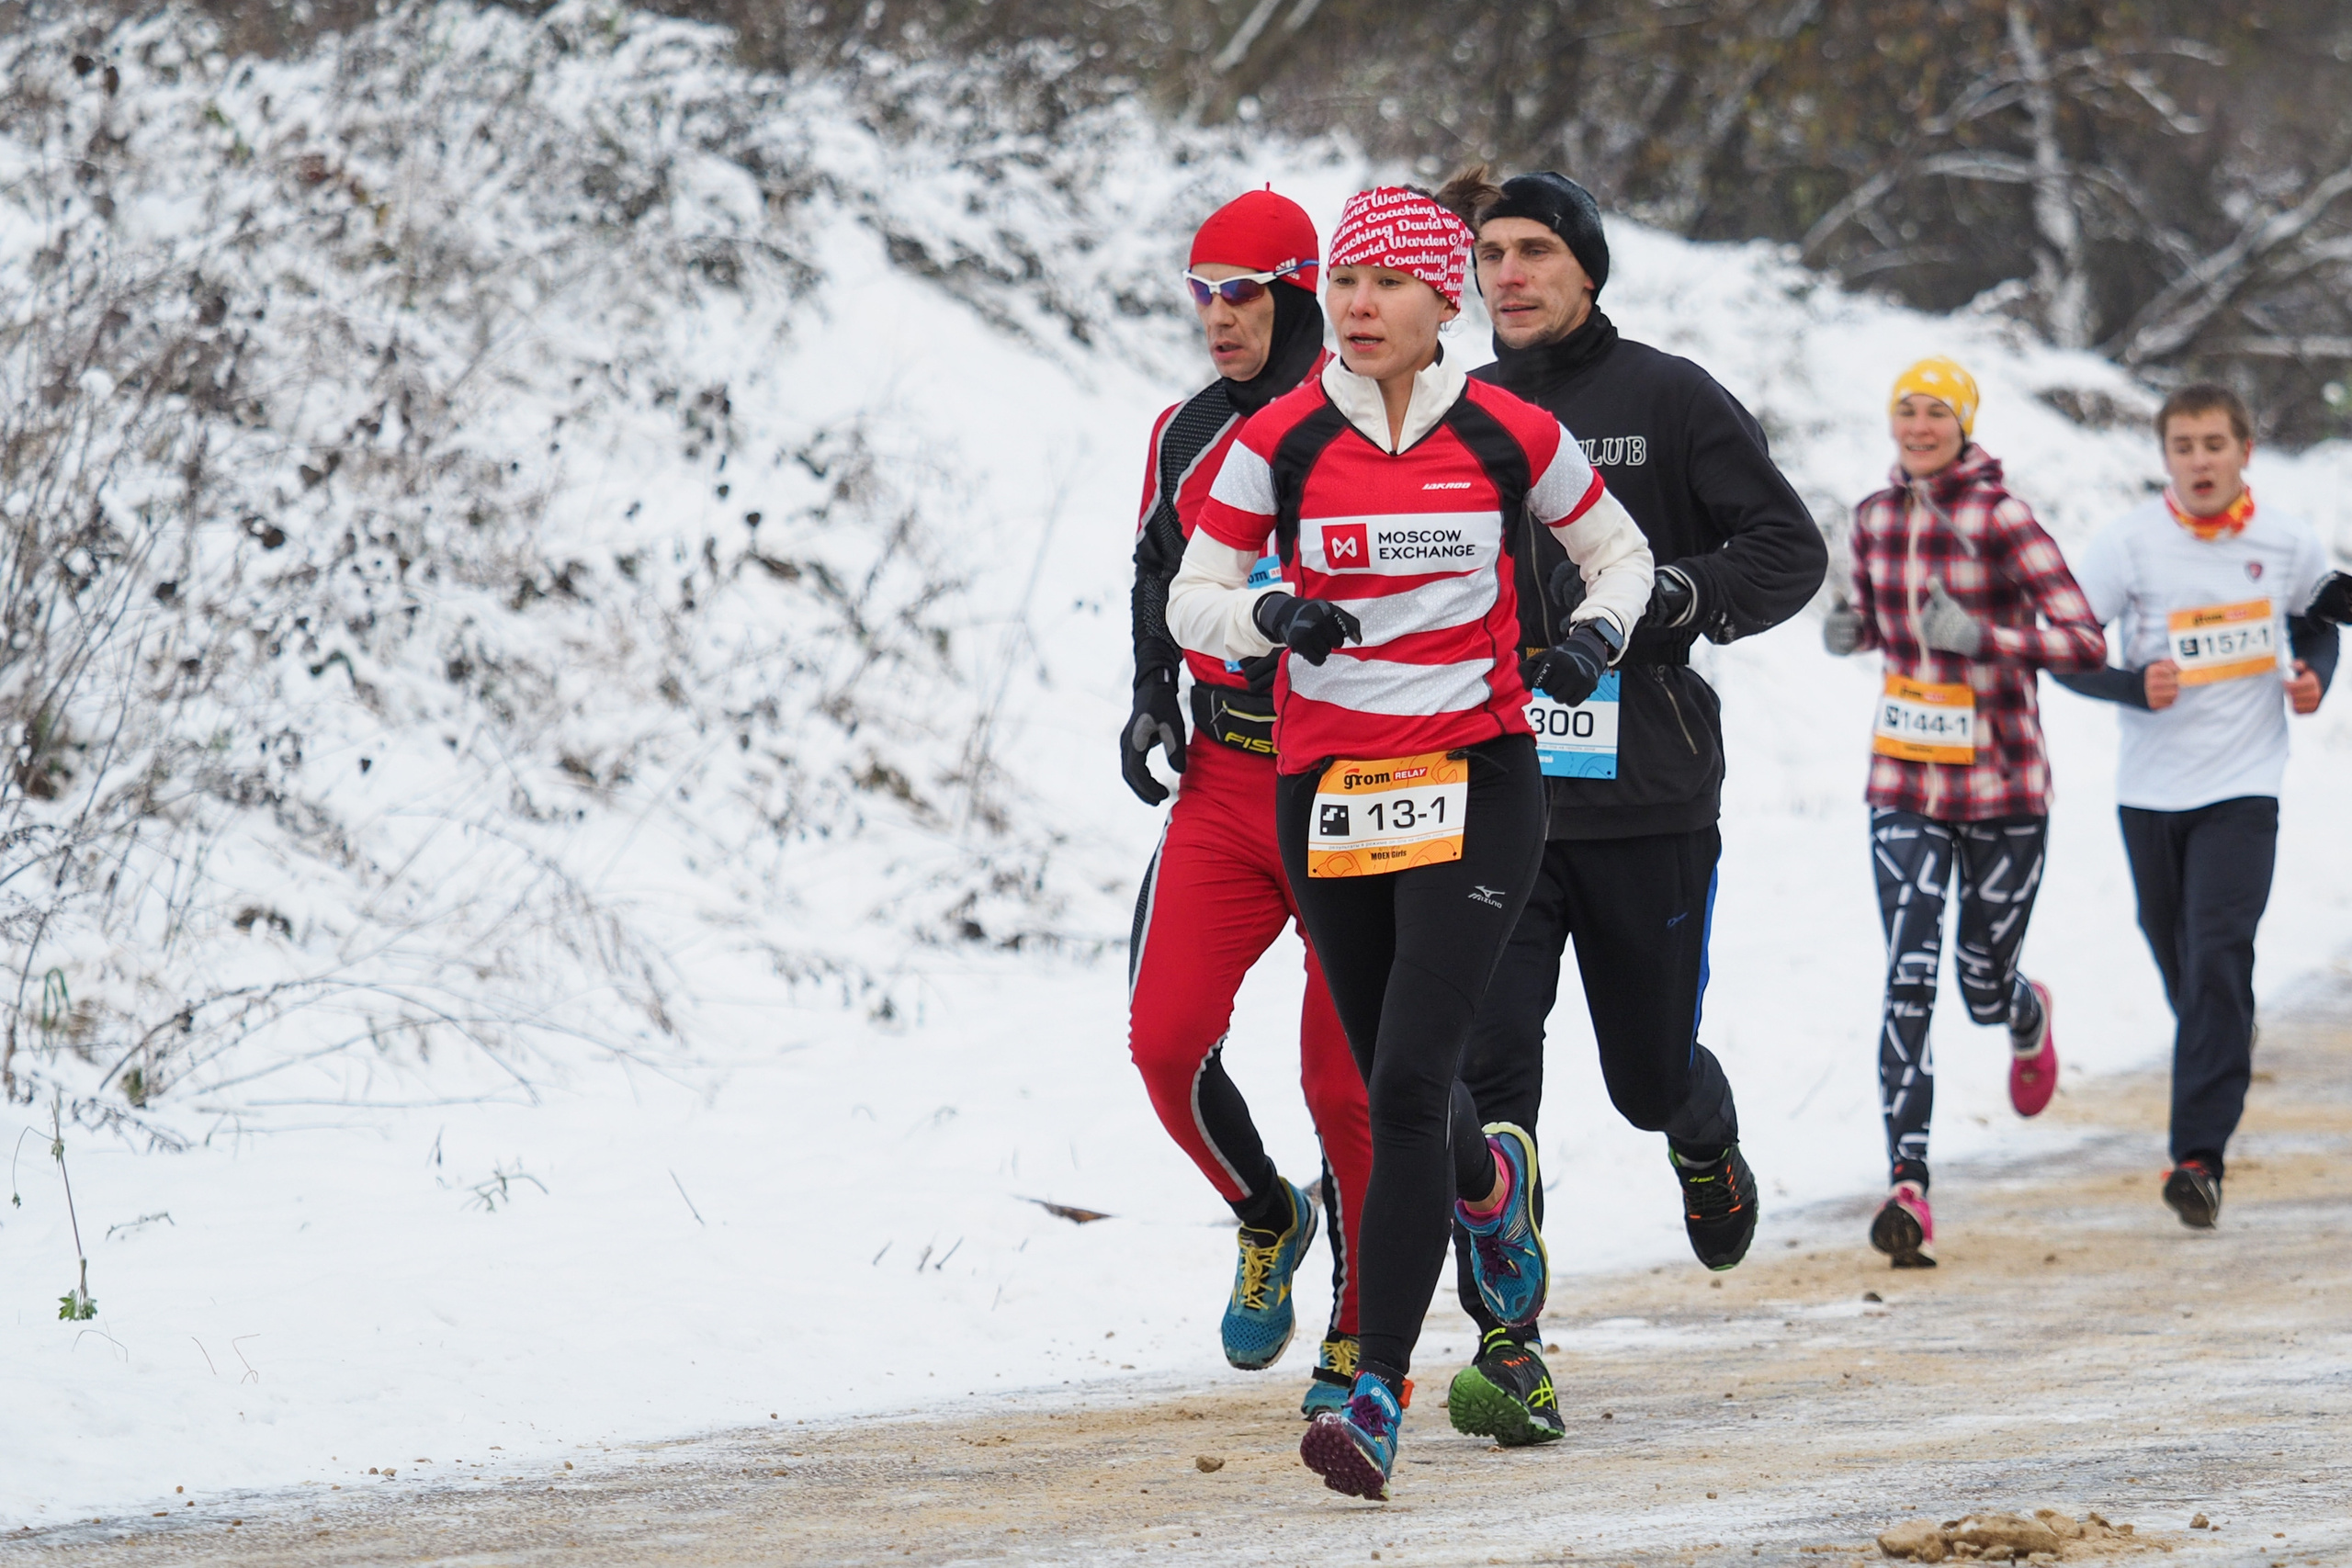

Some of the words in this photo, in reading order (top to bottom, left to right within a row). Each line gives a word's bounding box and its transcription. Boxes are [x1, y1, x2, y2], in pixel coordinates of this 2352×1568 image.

[1365, 203, 1436, 224] Coaching
[1396, 217, 1442, 232] David
[1339, 239, 1387, 266] David
[1388, 233, 1448, 251] Warden
[1384, 250, 1448, 269] Coaching
[1412, 267, 1448, 282] David
[1577, 435, 1646, 467] LUB
[1378, 529, 1462, 545] MOSCOW
[1379, 544, 1476, 559] EXCHANGE
[2201, 627, 2269, 657] 157-1
[1530, 707, 1594, 738] 300
[1900, 710, 1968, 737] 144-1
[1343, 769, 1391, 790] grom
[1394, 768, 1427, 780] RELAY
[1367, 795, 1446, 831] 13-1
[1371, 851, 1390, 861] MOEX
[1391, 849, 1408, 859] Girls
